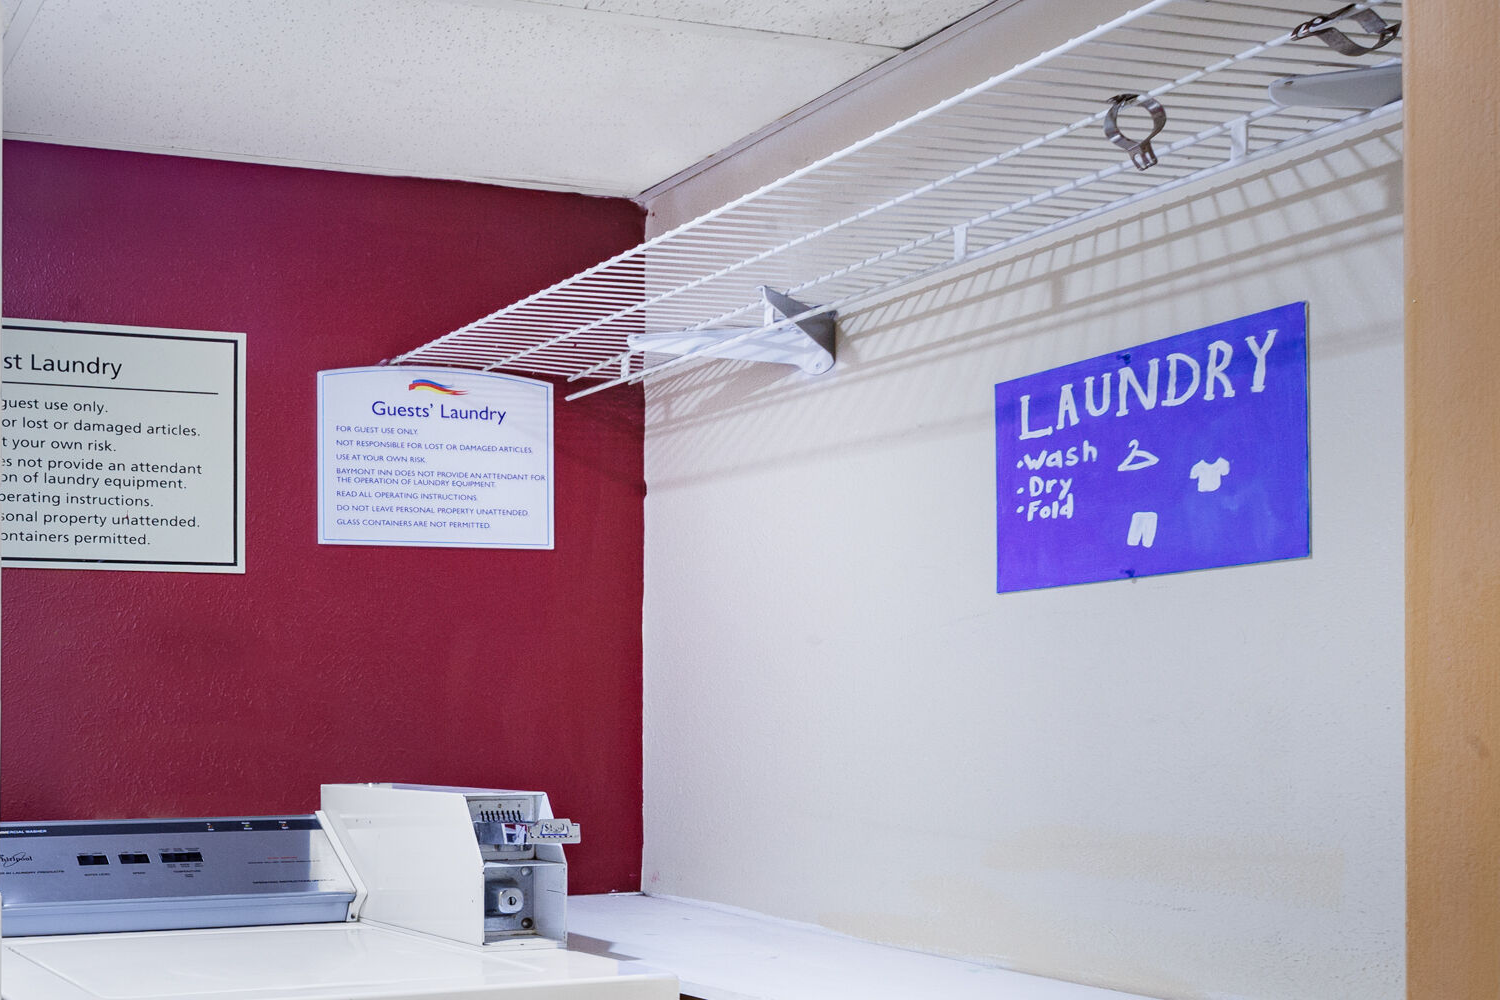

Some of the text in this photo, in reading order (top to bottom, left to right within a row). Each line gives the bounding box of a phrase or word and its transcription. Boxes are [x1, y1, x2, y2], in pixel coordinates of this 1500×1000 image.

[31, 354, 122, 380] Laundry
[1019, 329, 1278, 440] LAUNDRY
[44, 402, 68, 411] use
[74, 401, 108, 415] only.
[440, 404, 506, 425] Laundry
[22, 417, 48, 429] lost
[54, 421, 69, 430] or
[74, 420, 142, 436] damaged
[146, 424, 201, 437] articles.
[354, 426, 379, 434] GUEST
[381, 427, 395, 435] USE
[12, 439, 46, 450] your
[51, 440, 83, 450] own
[88, 440, 117, 452] risk.
[356, 440, 405, 449] RESPONSIBLE
[460, 444, 498, 452] DAMAGED
[362, 454, 384, 462] YOUR
[1024, 440, 1098, 470] Wash
[18, 458, 42, 468] not
[48, 459, 103, 471] provide
[108, 462, 126, 472] an
[131, 462, 202, 475] attendant
[23, 472, 39, 483] of
[44, 472, 100, 488] laundry
[104, 476, 187, 490] equipment.
[354, 477, 399, 485] OPERATION
[418, 470, 435, 478] NOT
[437, 471, 468, 479] PROVIDE
[483, 473, 529, 481] ATTENDANT
[1029, 476, 1073, 500] Dry
[66, 493, 154, 507] instructions.
[375, 492, 419, 500] OPERATING
[336, 504, 350, 512] DO
[396, 506, 435, 514] PERSONAL
[1027, 493, 1074, 522] Fold
[44, 514, 107, 527] property
[112, 516, 200, 528] unattended.
[336, 518, 360, 526] GLASS
[362, 519, 412, 527] CONTAINERS
[414, 520, 428, 528] ARE
[74, 533, 151, 546] permitted.
